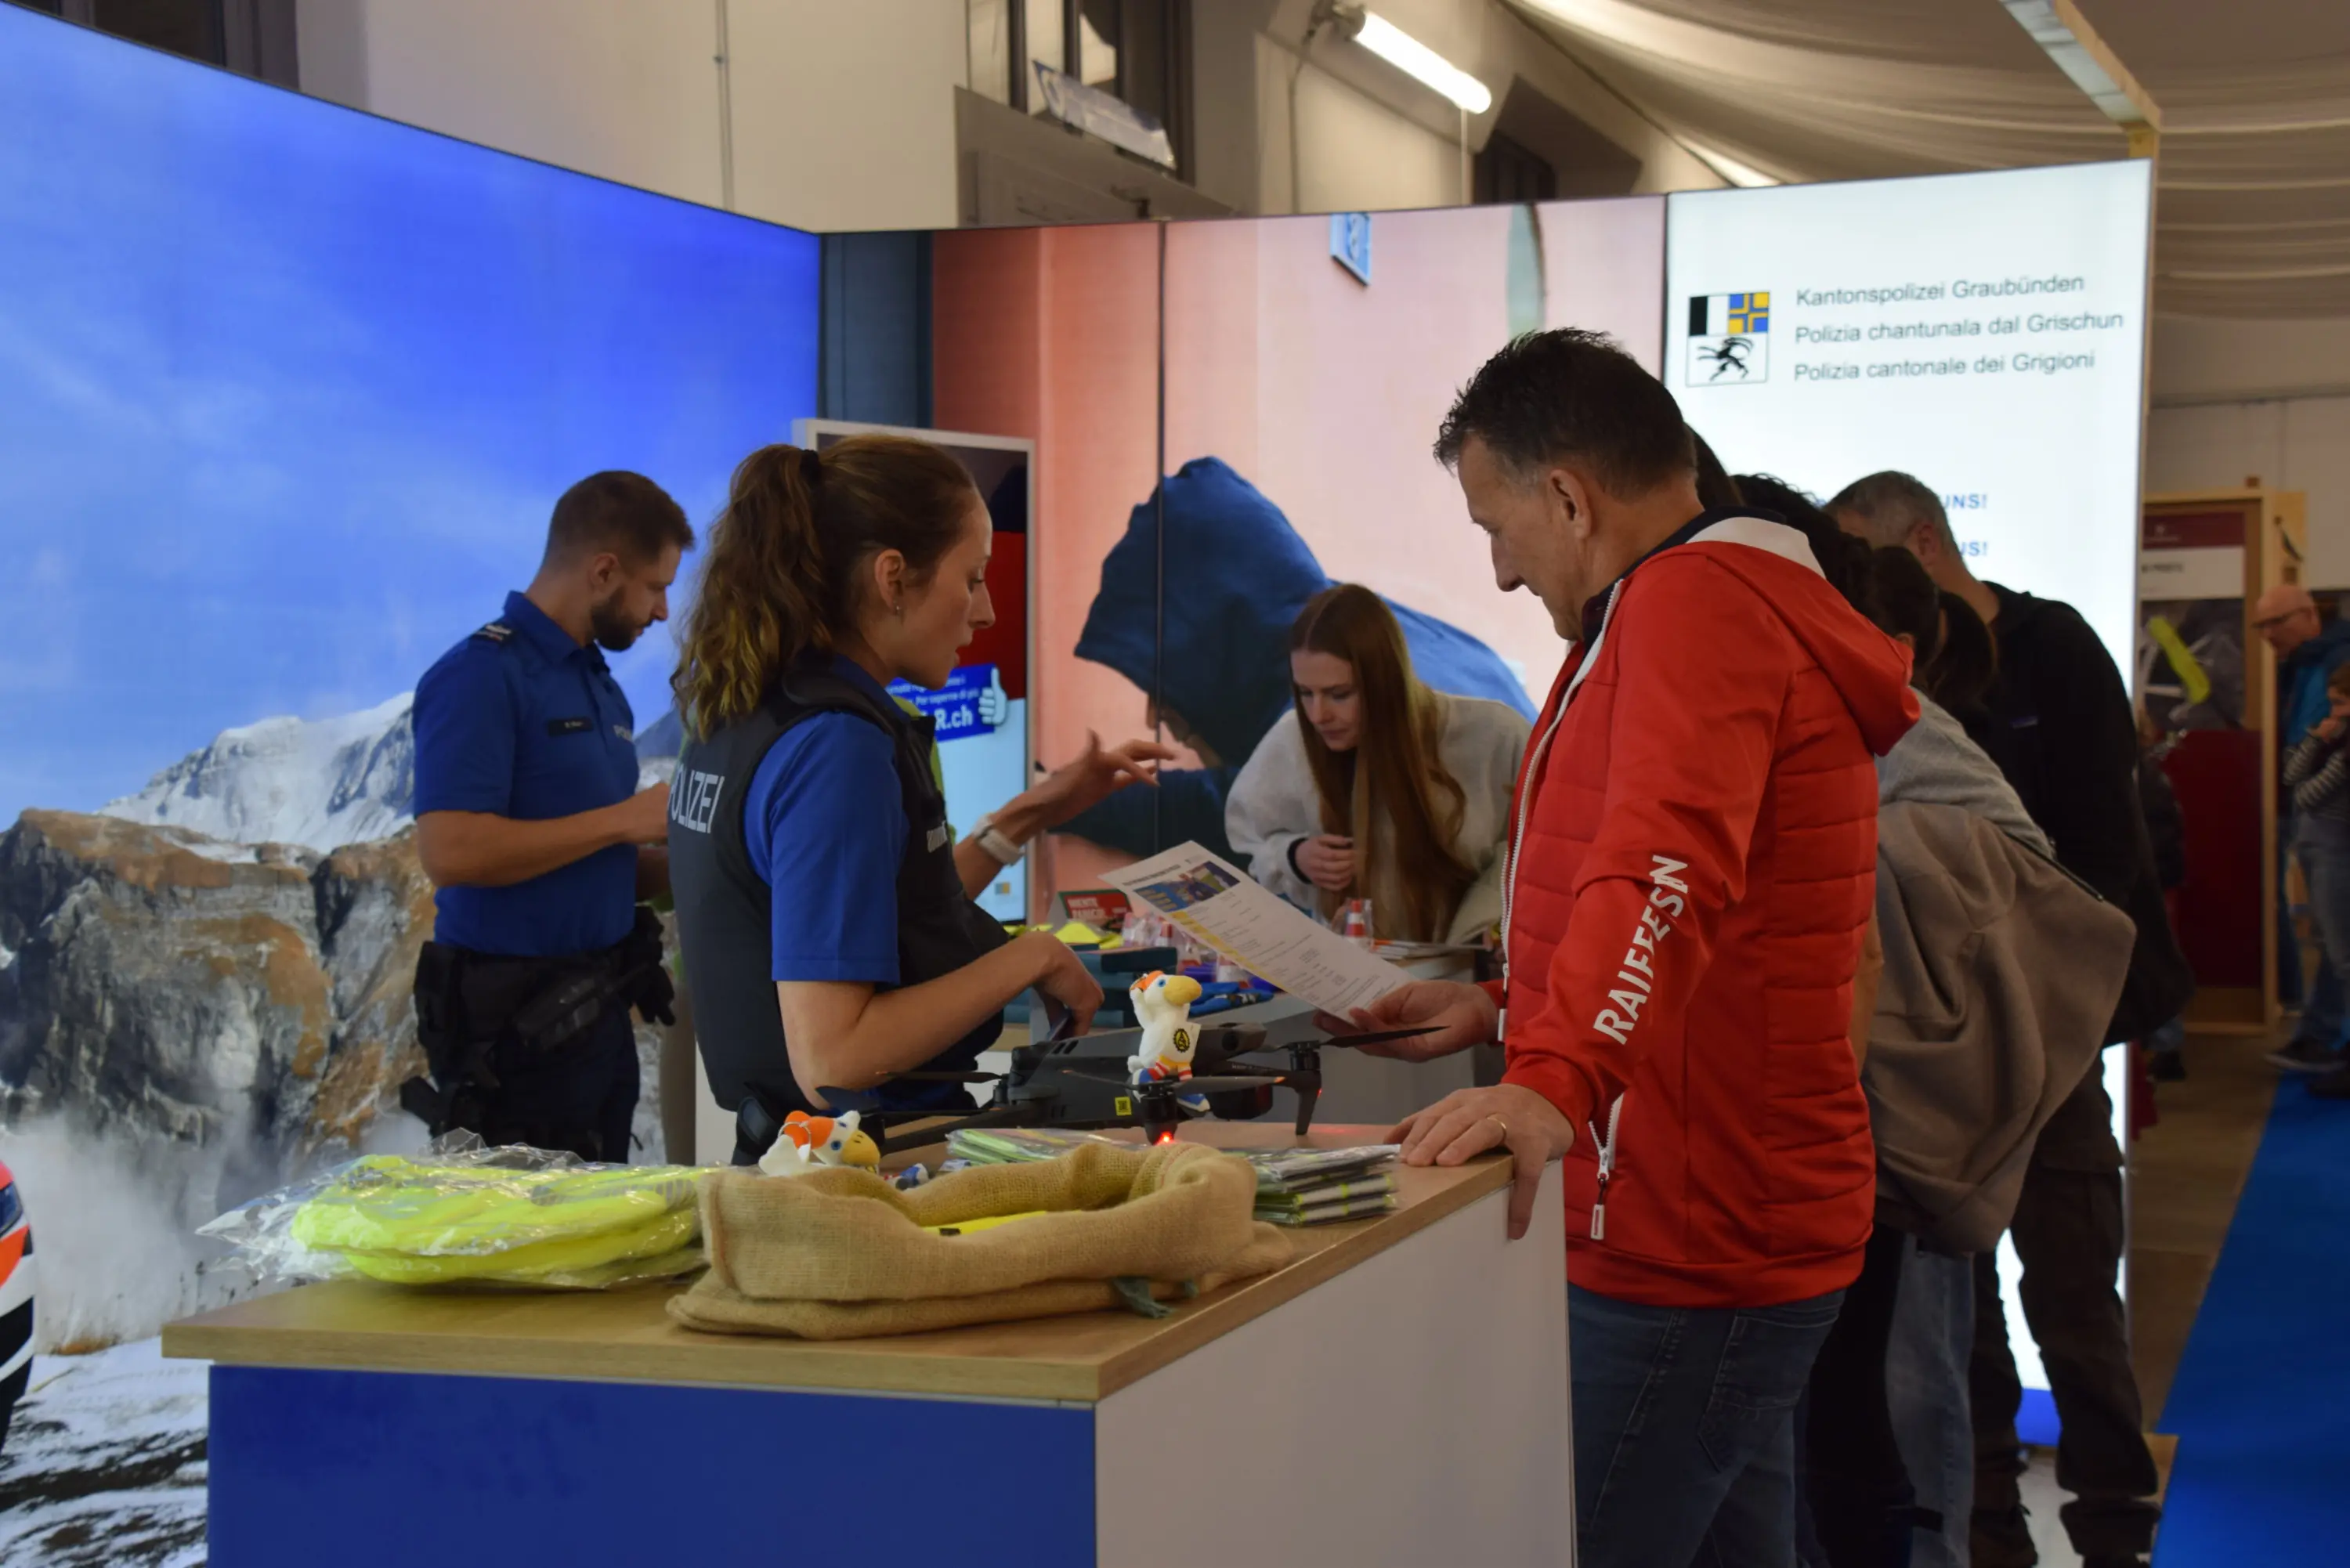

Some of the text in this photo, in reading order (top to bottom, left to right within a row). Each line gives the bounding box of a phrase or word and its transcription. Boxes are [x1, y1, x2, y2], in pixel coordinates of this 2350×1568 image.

[1796, 274, 2084, 306] Kantonspolizei Graubünden
[1795, 311, 2124, 344] Polizia chantunala dal Grischun
[1795, 349, 2095, 381] Polizia cantonale dei Grigioni
[921, 705, 974, 731] R.ch
[670, 764, 725, 834] OLIZEI
